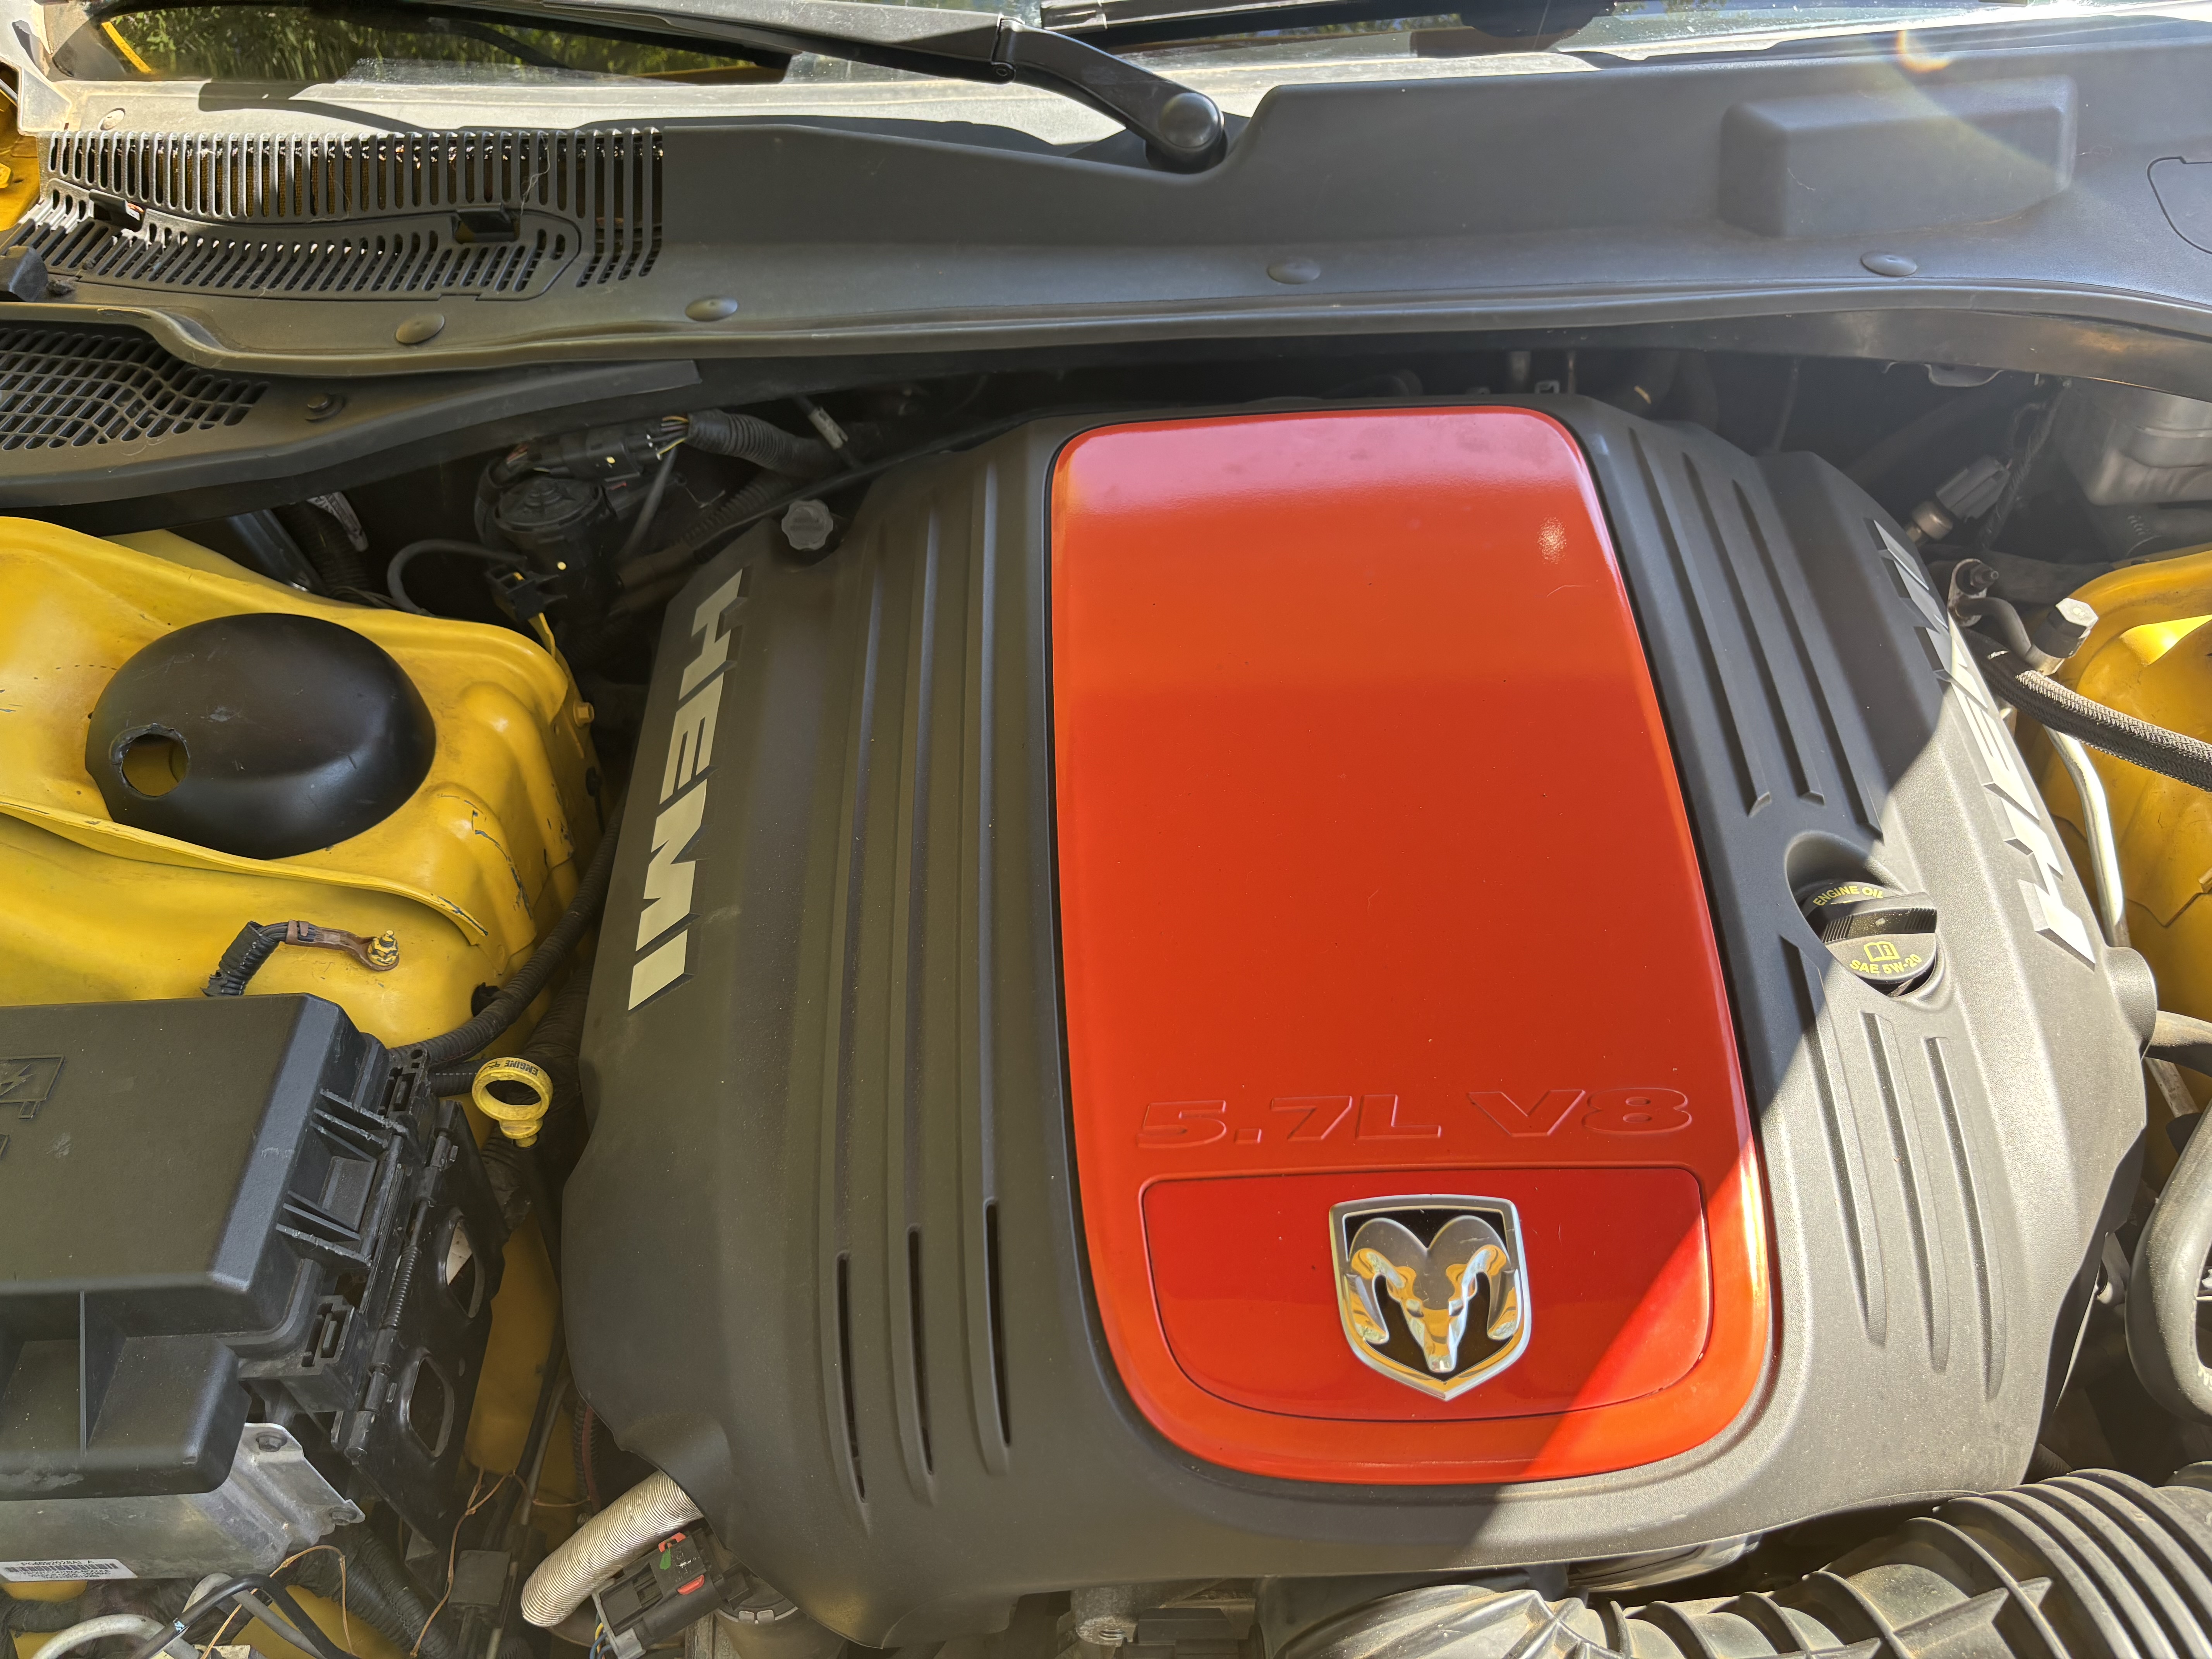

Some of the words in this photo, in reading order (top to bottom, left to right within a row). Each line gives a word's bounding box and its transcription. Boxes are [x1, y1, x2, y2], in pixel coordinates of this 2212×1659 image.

[1874, 520, 2096, 964] HEMI
[628, 568, 743, 1011] HEMI
[1812, 885, 1860, 906] ENGINE
[1862, 886, 1884, 899] OIL
[1850, 960, 1880, 974] SAE
[1882, 953, 1922, 974] 5W-20
[504, 1060, 539, 1077] ENGINE
[1135, 1094, 1441, 1149] 5.7L
[1466, 1087, 1692, 1138] V8
